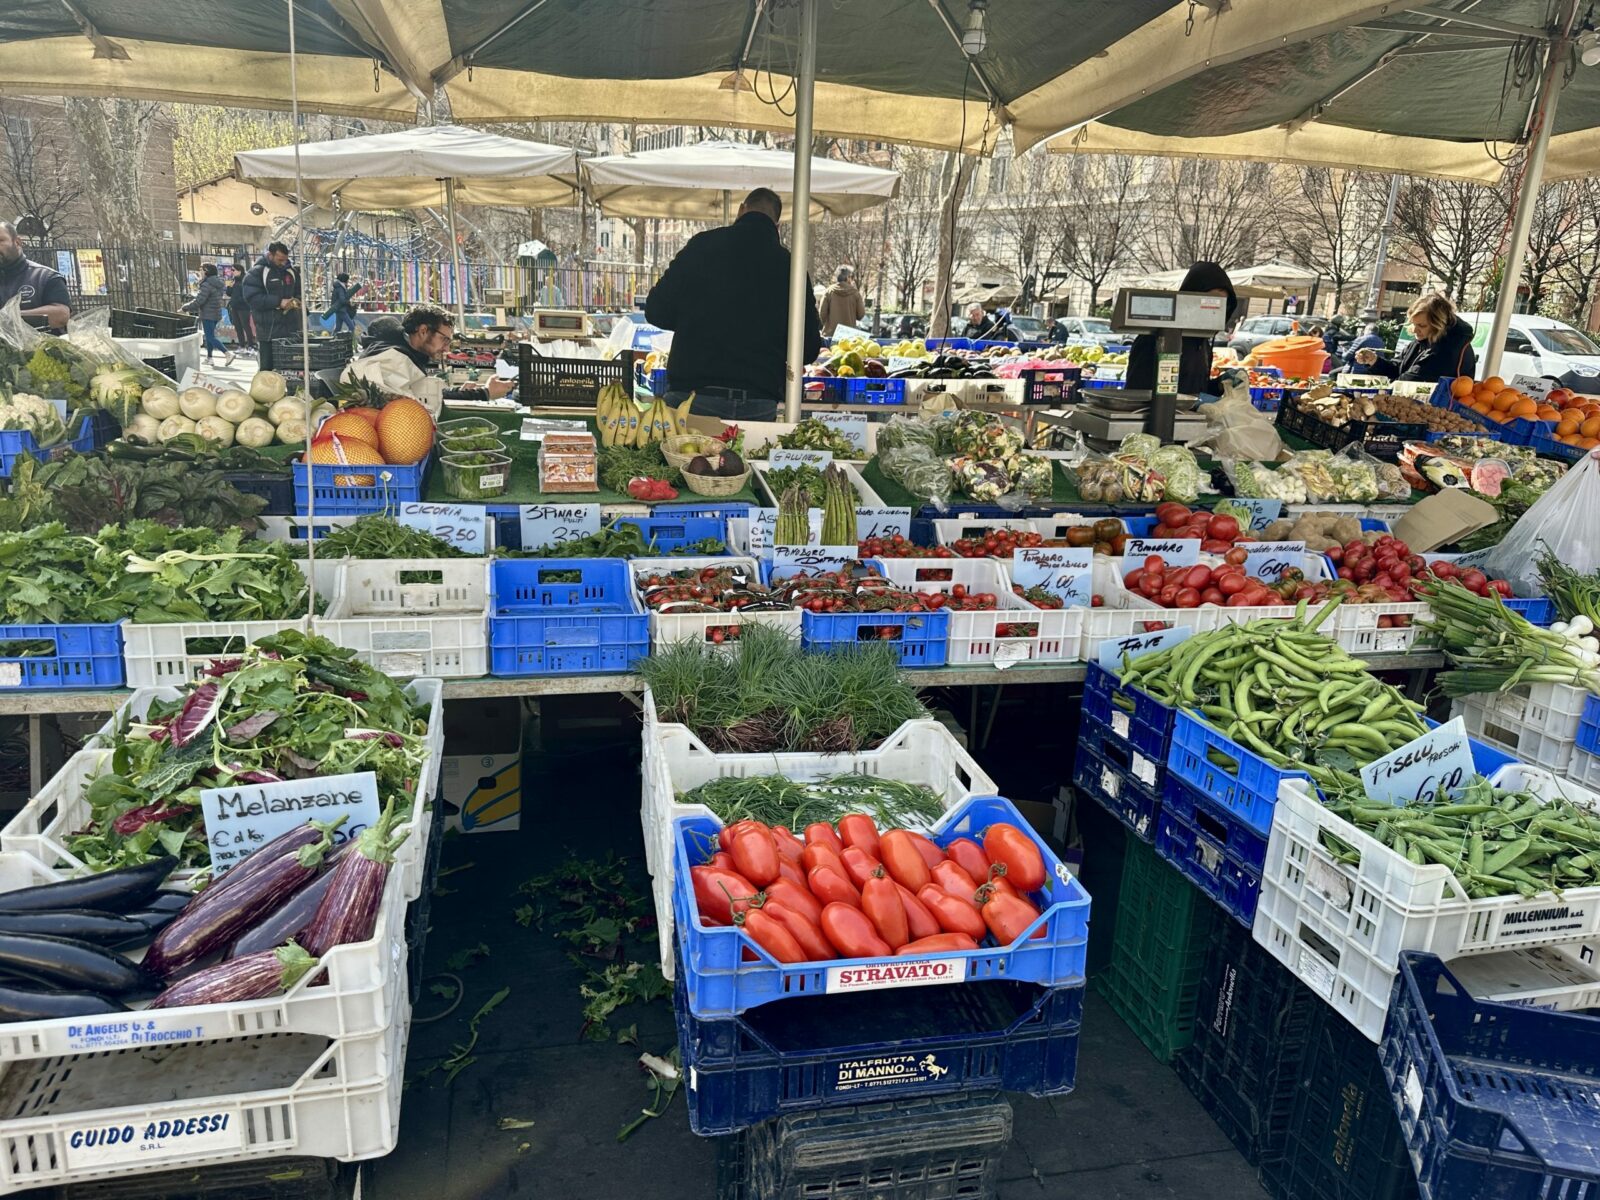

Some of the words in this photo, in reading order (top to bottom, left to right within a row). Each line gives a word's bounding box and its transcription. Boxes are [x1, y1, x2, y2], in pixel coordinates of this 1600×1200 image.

[1117, 636, 1164, 659] FAVE
[216, 789, 364, 821] Melanzane
[1503, 906, 1570, 925] MILLENNIUM
[839, 963, 948, 984] STRAVATO
[145, 1028, 193, 1043] TROCCHIO
[838, 1069, 853, 1081] DI
[855, 1064, 905, 1079] MANNO
[839, 1055, 916, 1070] ITALFRUTTA
[70, 1125, 135, 1149] GUIDO
[144, 1113, 230, 1141] ADDESSI
